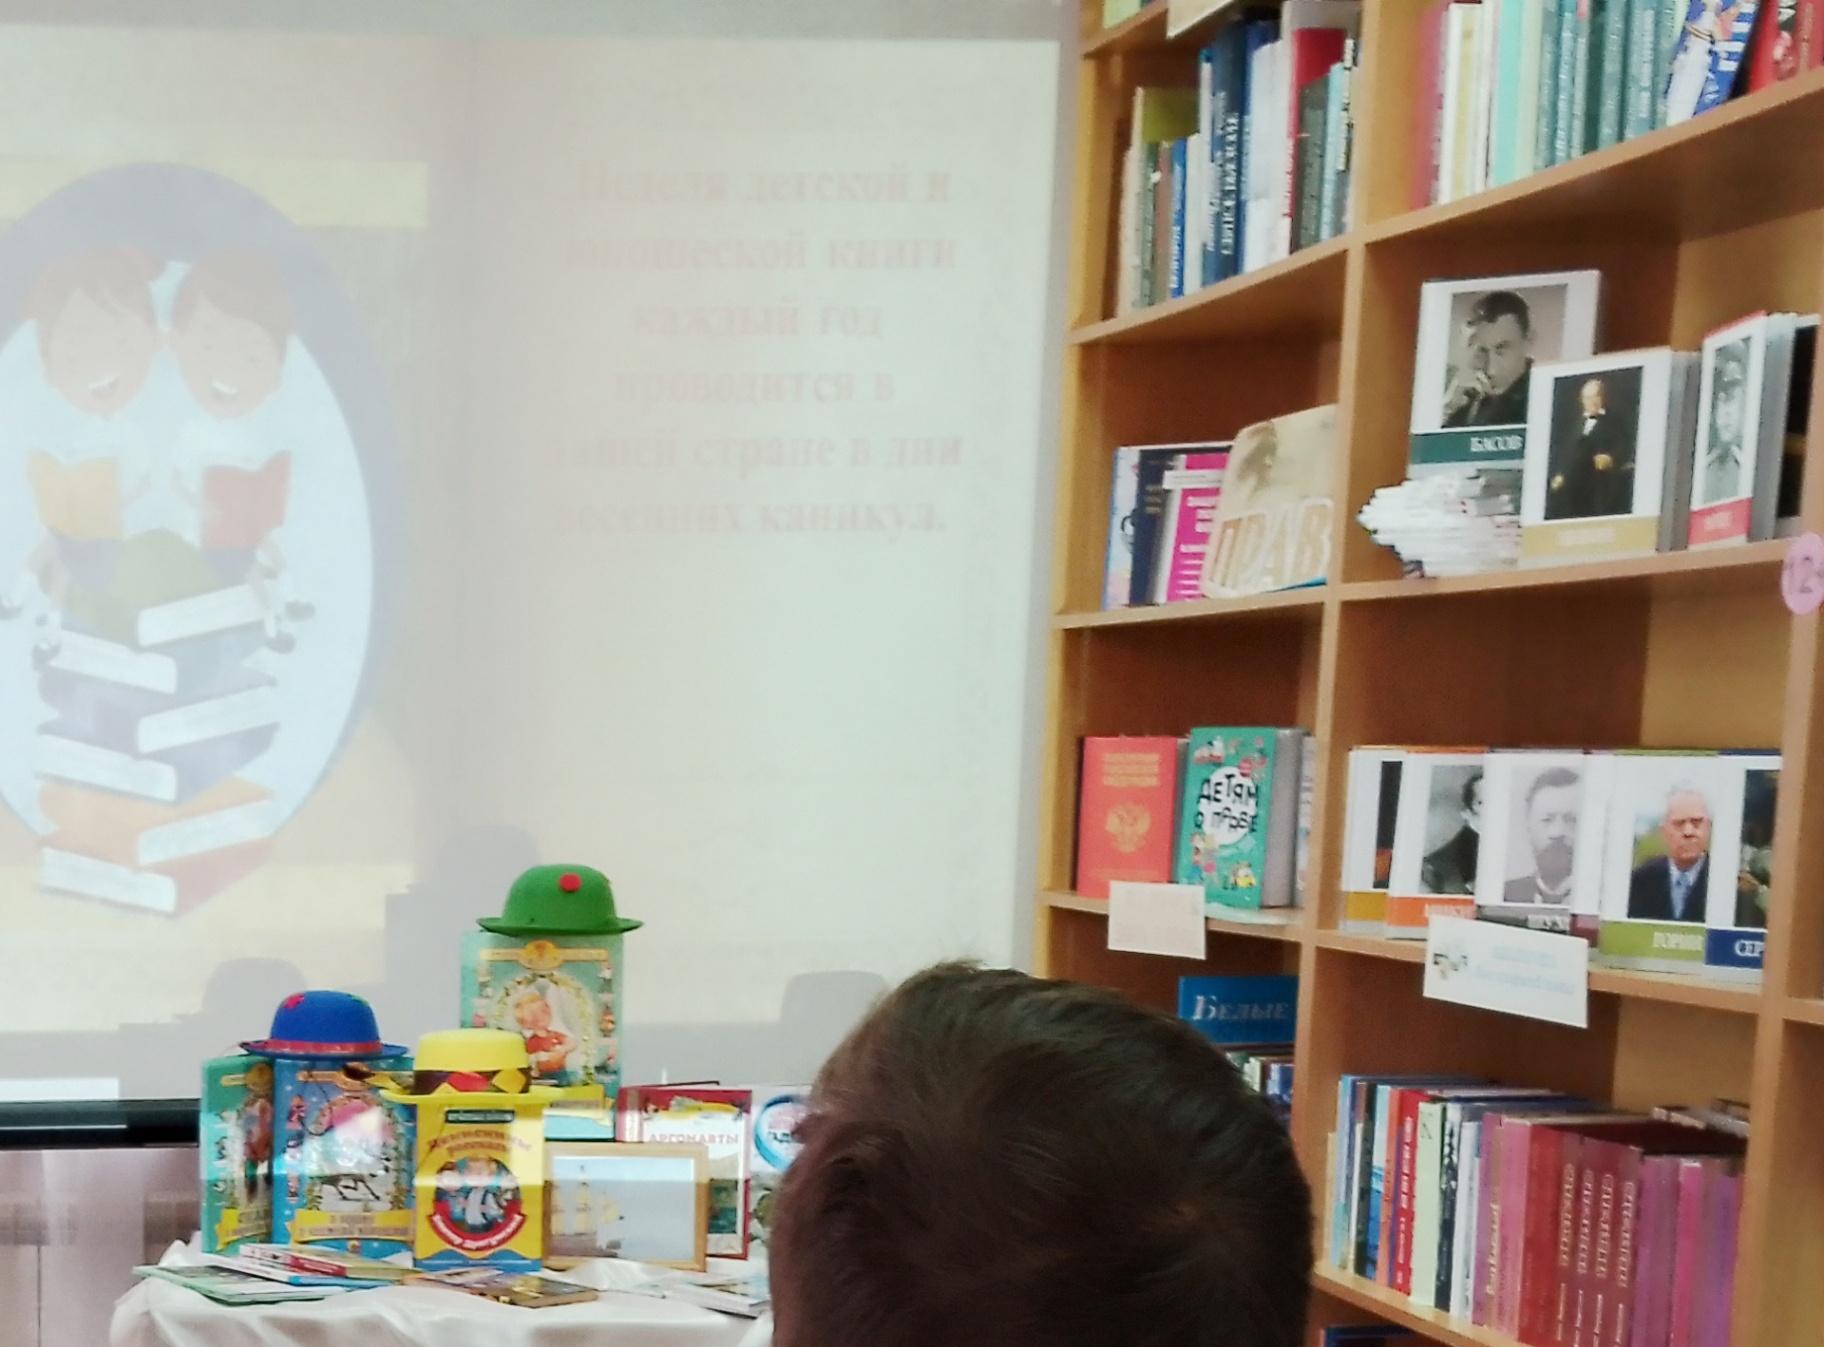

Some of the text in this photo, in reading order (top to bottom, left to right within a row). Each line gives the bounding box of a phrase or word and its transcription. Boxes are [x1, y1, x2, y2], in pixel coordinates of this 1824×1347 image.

[747, 161, 911, 205] детской
[925, 171, 952, 203] и
[828, 238, 956, 271] книги
[633, 296, 884, 340] каждый год
[613, 371, 896, 417] проводится в
[692, 437, 837, 479] стране
[849, 439, 872, 467] в
[884, 437, 964, 469] дни
